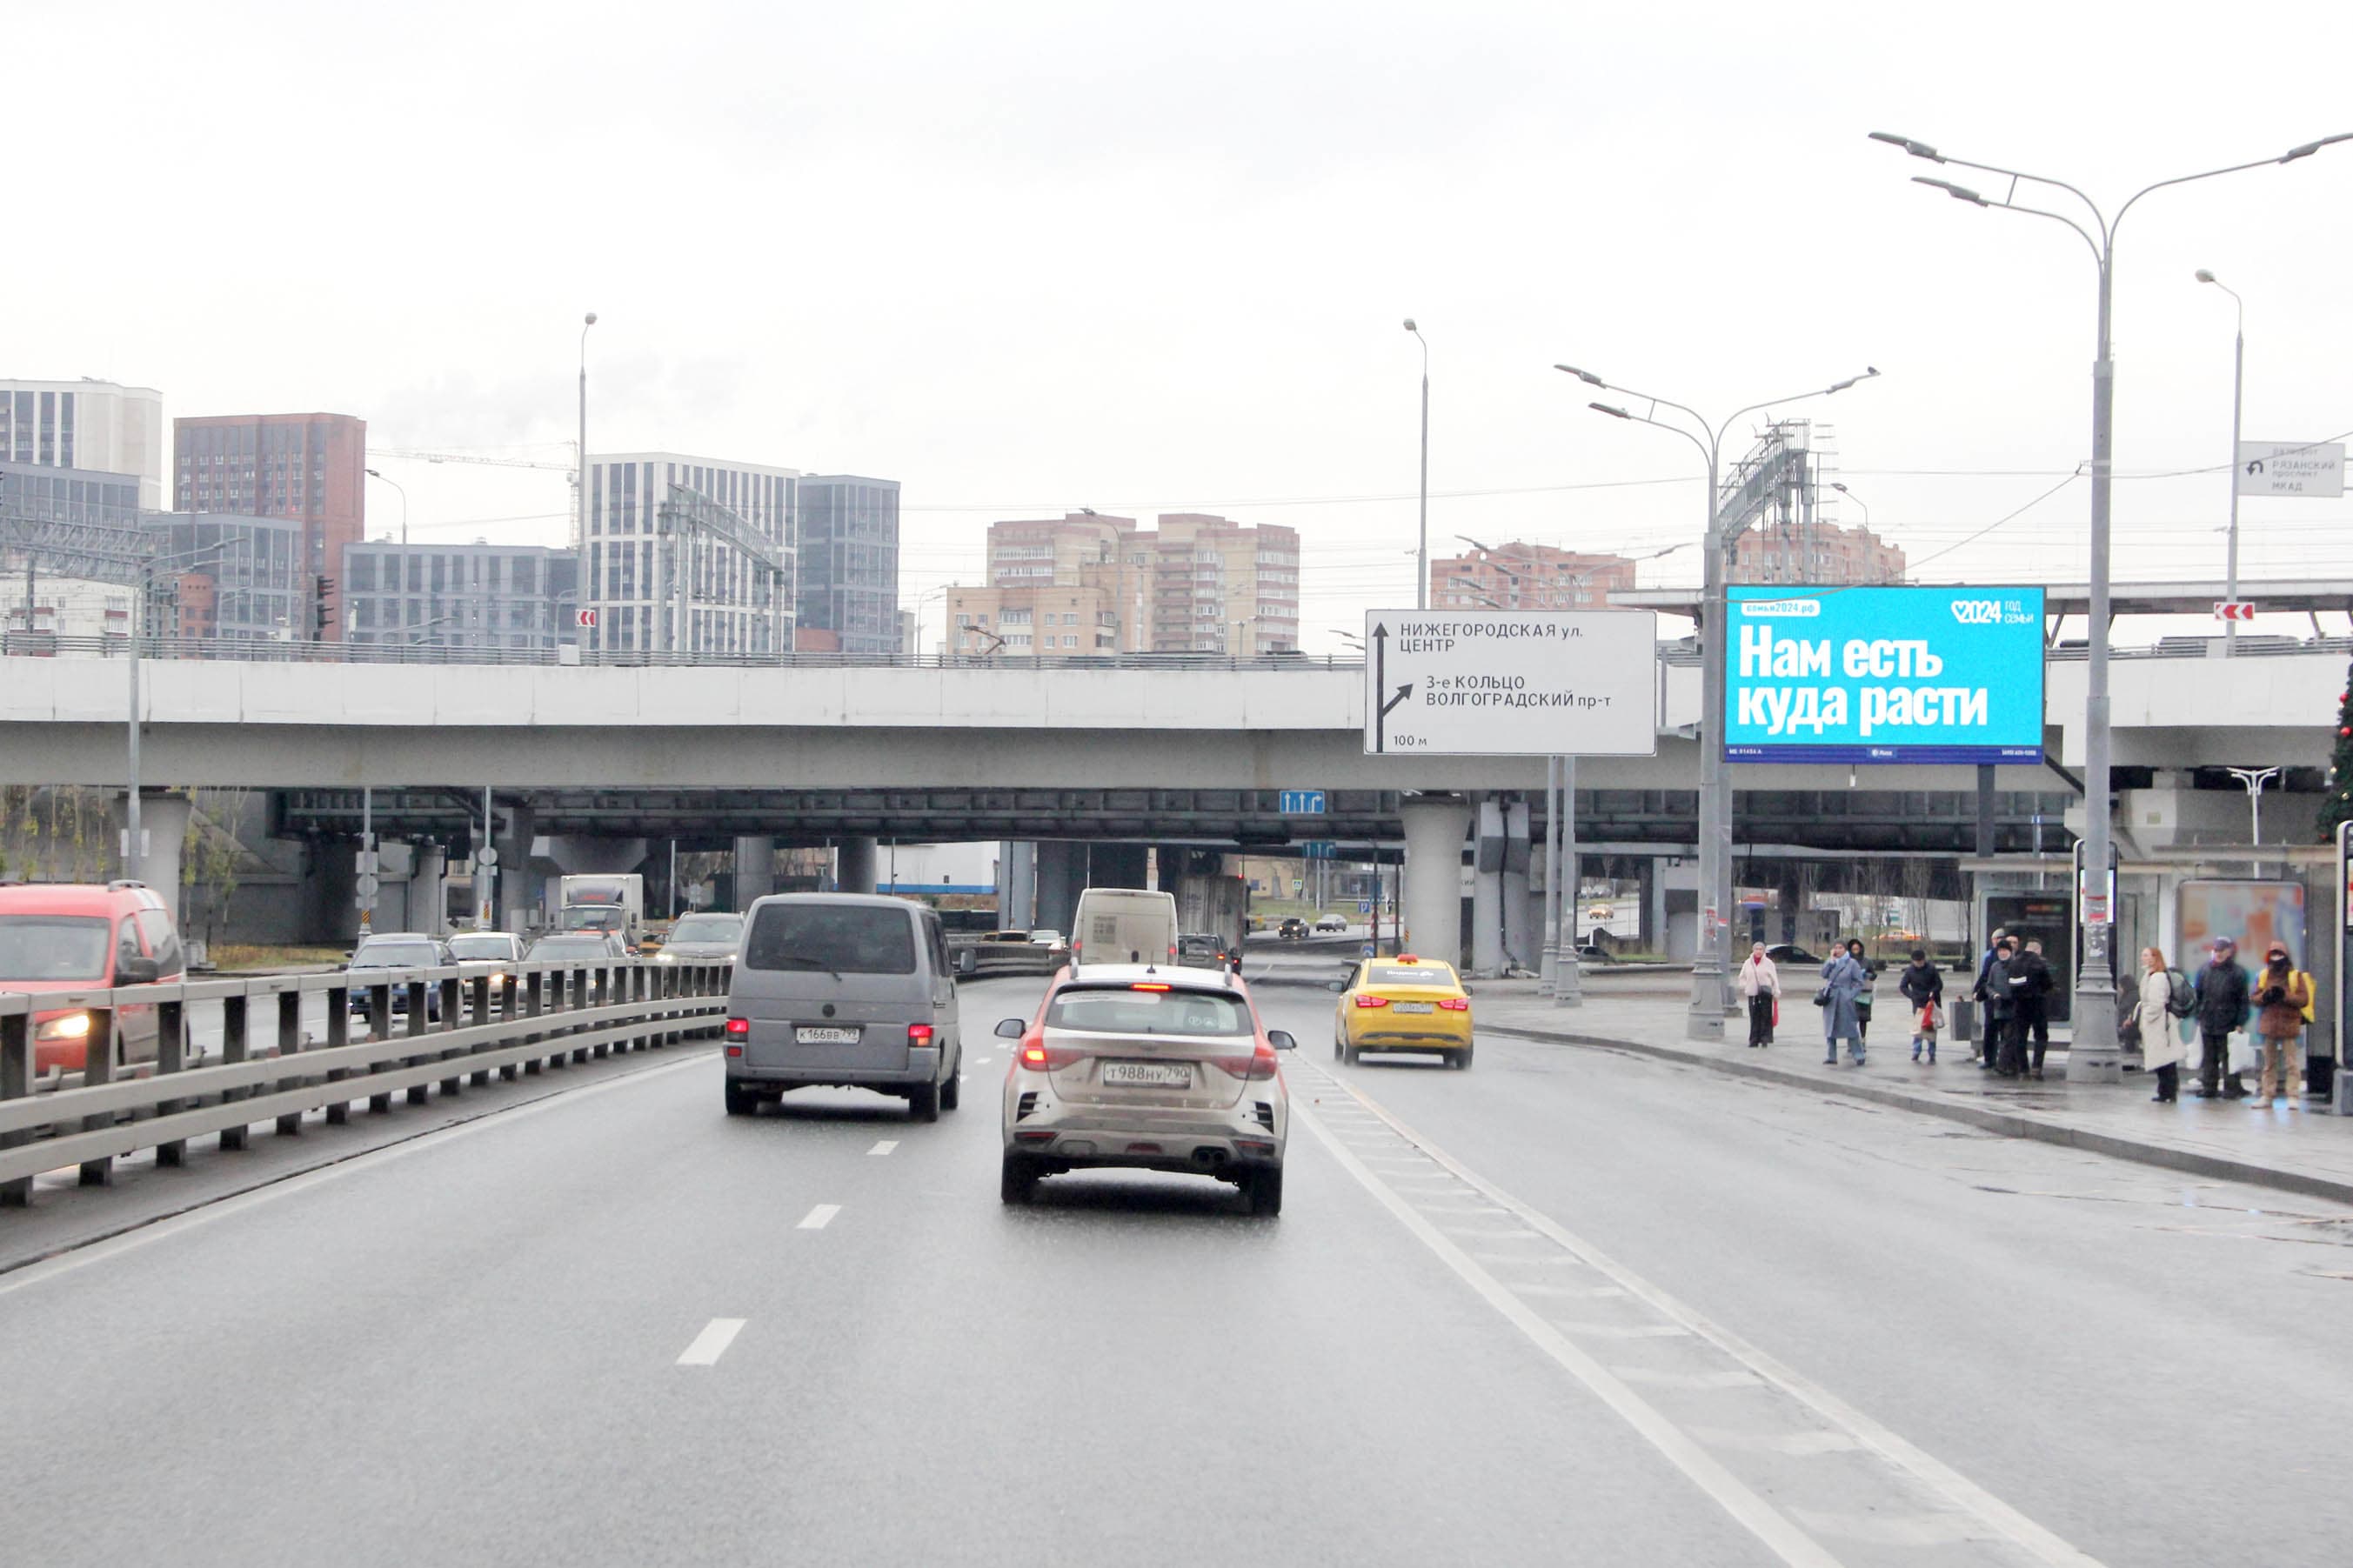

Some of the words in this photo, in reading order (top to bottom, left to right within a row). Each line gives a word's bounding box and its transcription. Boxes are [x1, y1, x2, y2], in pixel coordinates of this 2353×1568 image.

[2272, 481, 2303, 492] МКАД
[1956, 600, 2002, 624] 2024
[1400, 623, 1556, 637] НИЖЕГОРОДСКАЯ
[1561, 625, 1583, 640] ул.
[1400, 638, 1455, 654] ЦЕНТР
[1739, 624, 1830, 677] Нам
[1843, 638, 1943, 677] есть
[1427, 675, 1451, 689] 3-е
[1455, 675, 1525, 691] КОЛЬЦО
[1427, 690, 1574, 708] ВОЛГОГРАДСКИЙ
[1578, 697, 1611, 710] пр-т
[1738, 686, 1848, 736] куда
[1860, 687, 1989, 737] расти
[1394, 735, 1415, 747] 100
[1418, 737, 1427, 746] м
